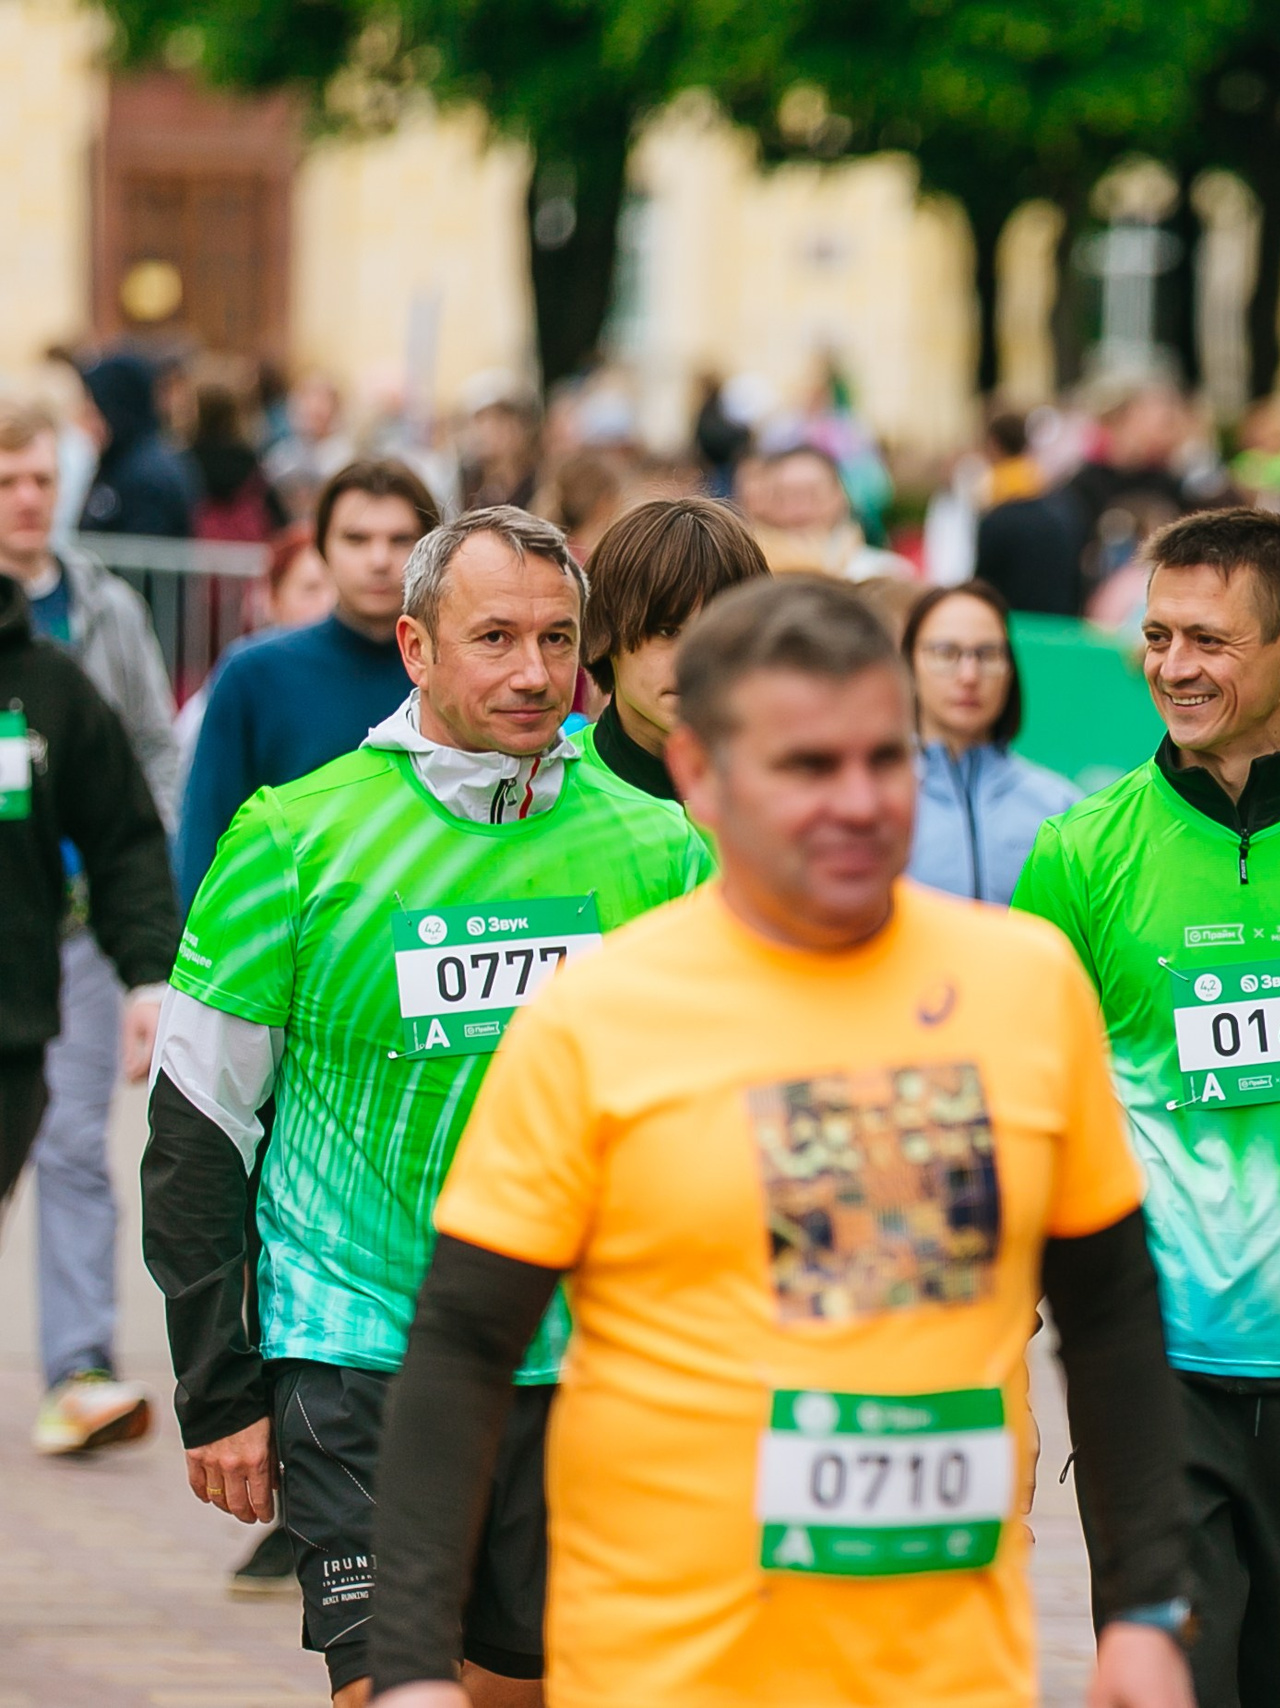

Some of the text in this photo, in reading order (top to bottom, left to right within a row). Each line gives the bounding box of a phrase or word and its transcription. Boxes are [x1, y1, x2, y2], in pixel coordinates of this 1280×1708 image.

[424, 921, 442, 936] 4,2
[488, 916, 529, 933] Звук
[1202, 930, 1236, 941] Прайм
[437, 945, 568, 1002] 0777
[1200, 979, 1217, 992] 4,2
[809, 1449, 970, 1510] 0710
[341, 1591, 369, 1601] RUNNING
